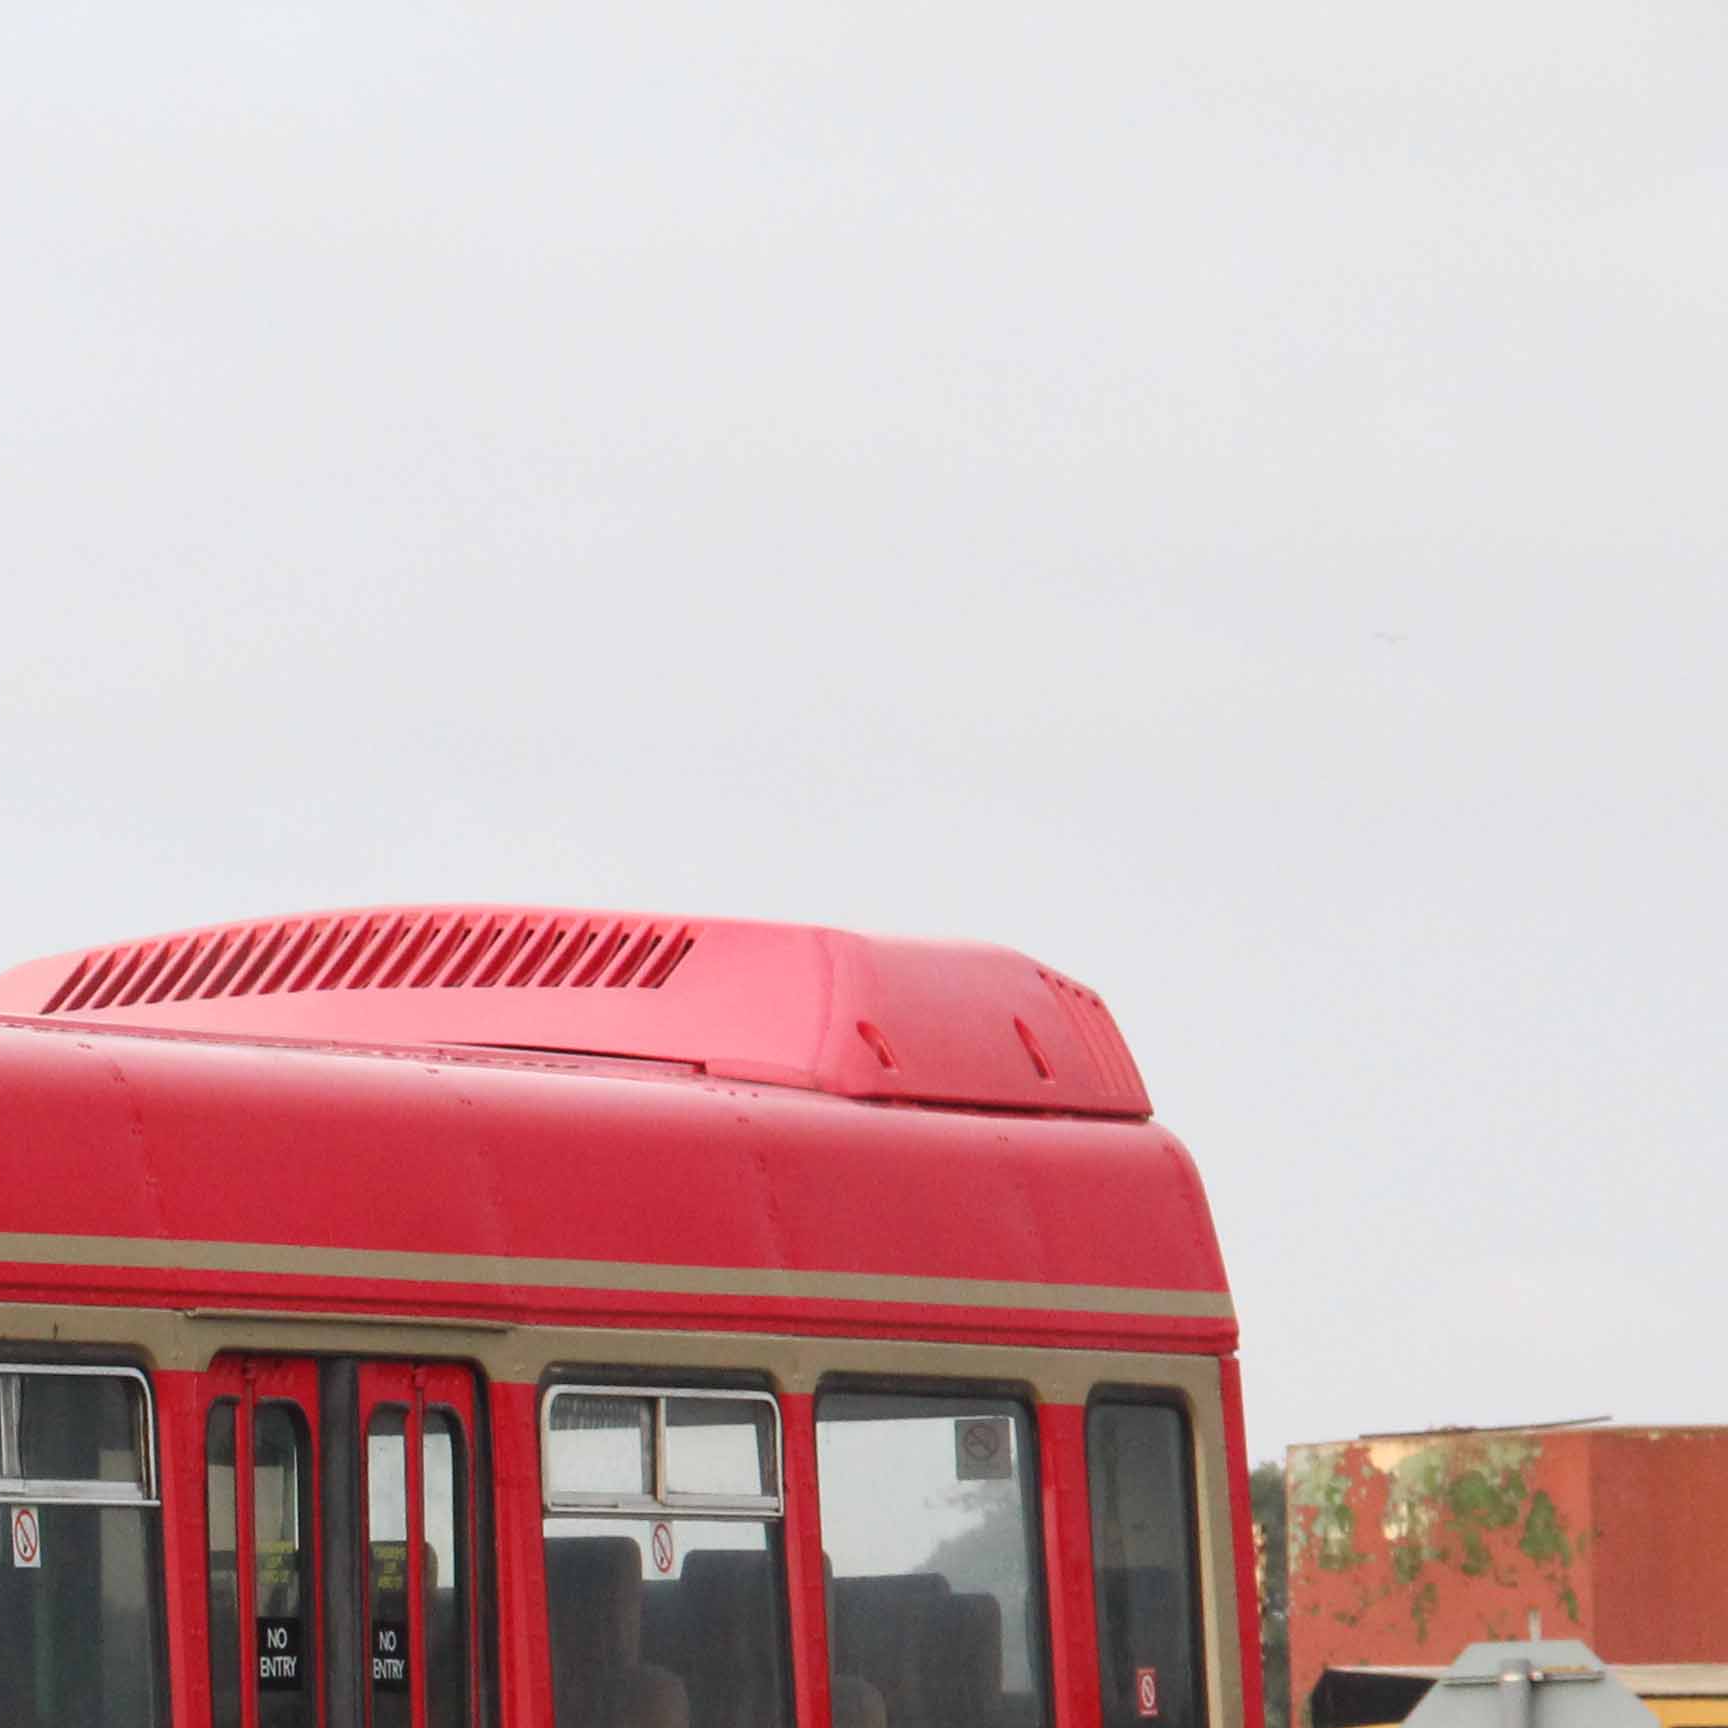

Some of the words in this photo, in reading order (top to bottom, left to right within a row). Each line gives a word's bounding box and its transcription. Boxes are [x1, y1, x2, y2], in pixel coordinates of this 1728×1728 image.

[266, 1627, 288, 1649] NO
[379, 1631, 397, 1651] NO
[259, 1656, 297, 1678] ENTRY
[372, 1658, 405, 1680] ENTRY
